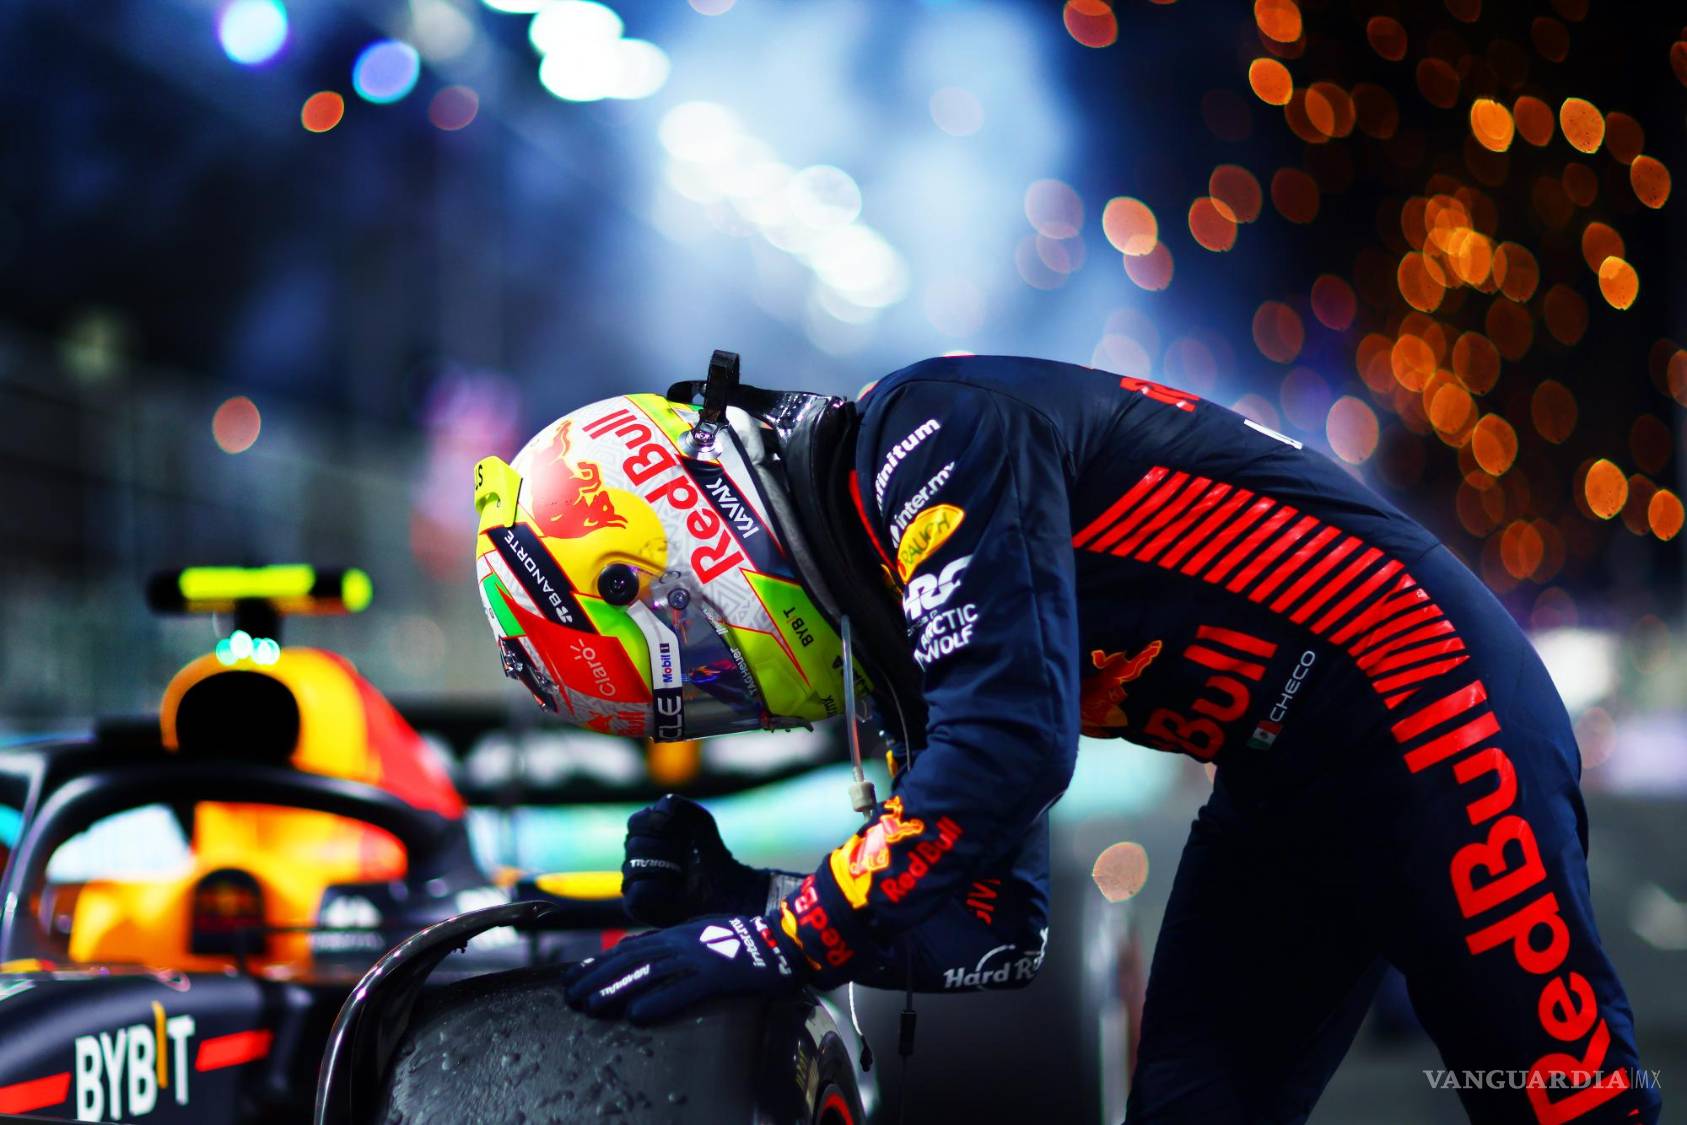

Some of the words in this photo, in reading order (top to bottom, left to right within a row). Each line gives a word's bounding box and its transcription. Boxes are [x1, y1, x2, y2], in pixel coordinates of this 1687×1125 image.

[706, 477, 760, 539] KAVAK
[901, 511, 951, 565] RAUCH
[504, 530, 563, 606] BANORTE
[914, 624, 973, 672] WOLF
[920, 604, 978, 650] ARCTIC
[582, 647, 616, 697] Claro
[660, 654, 673, 683] Mobil
[1269, 651, 1316, 723] CHECO
[943, 962, 1010, 989] Hard
[75, 1001, 195, 1123] BYBIT
